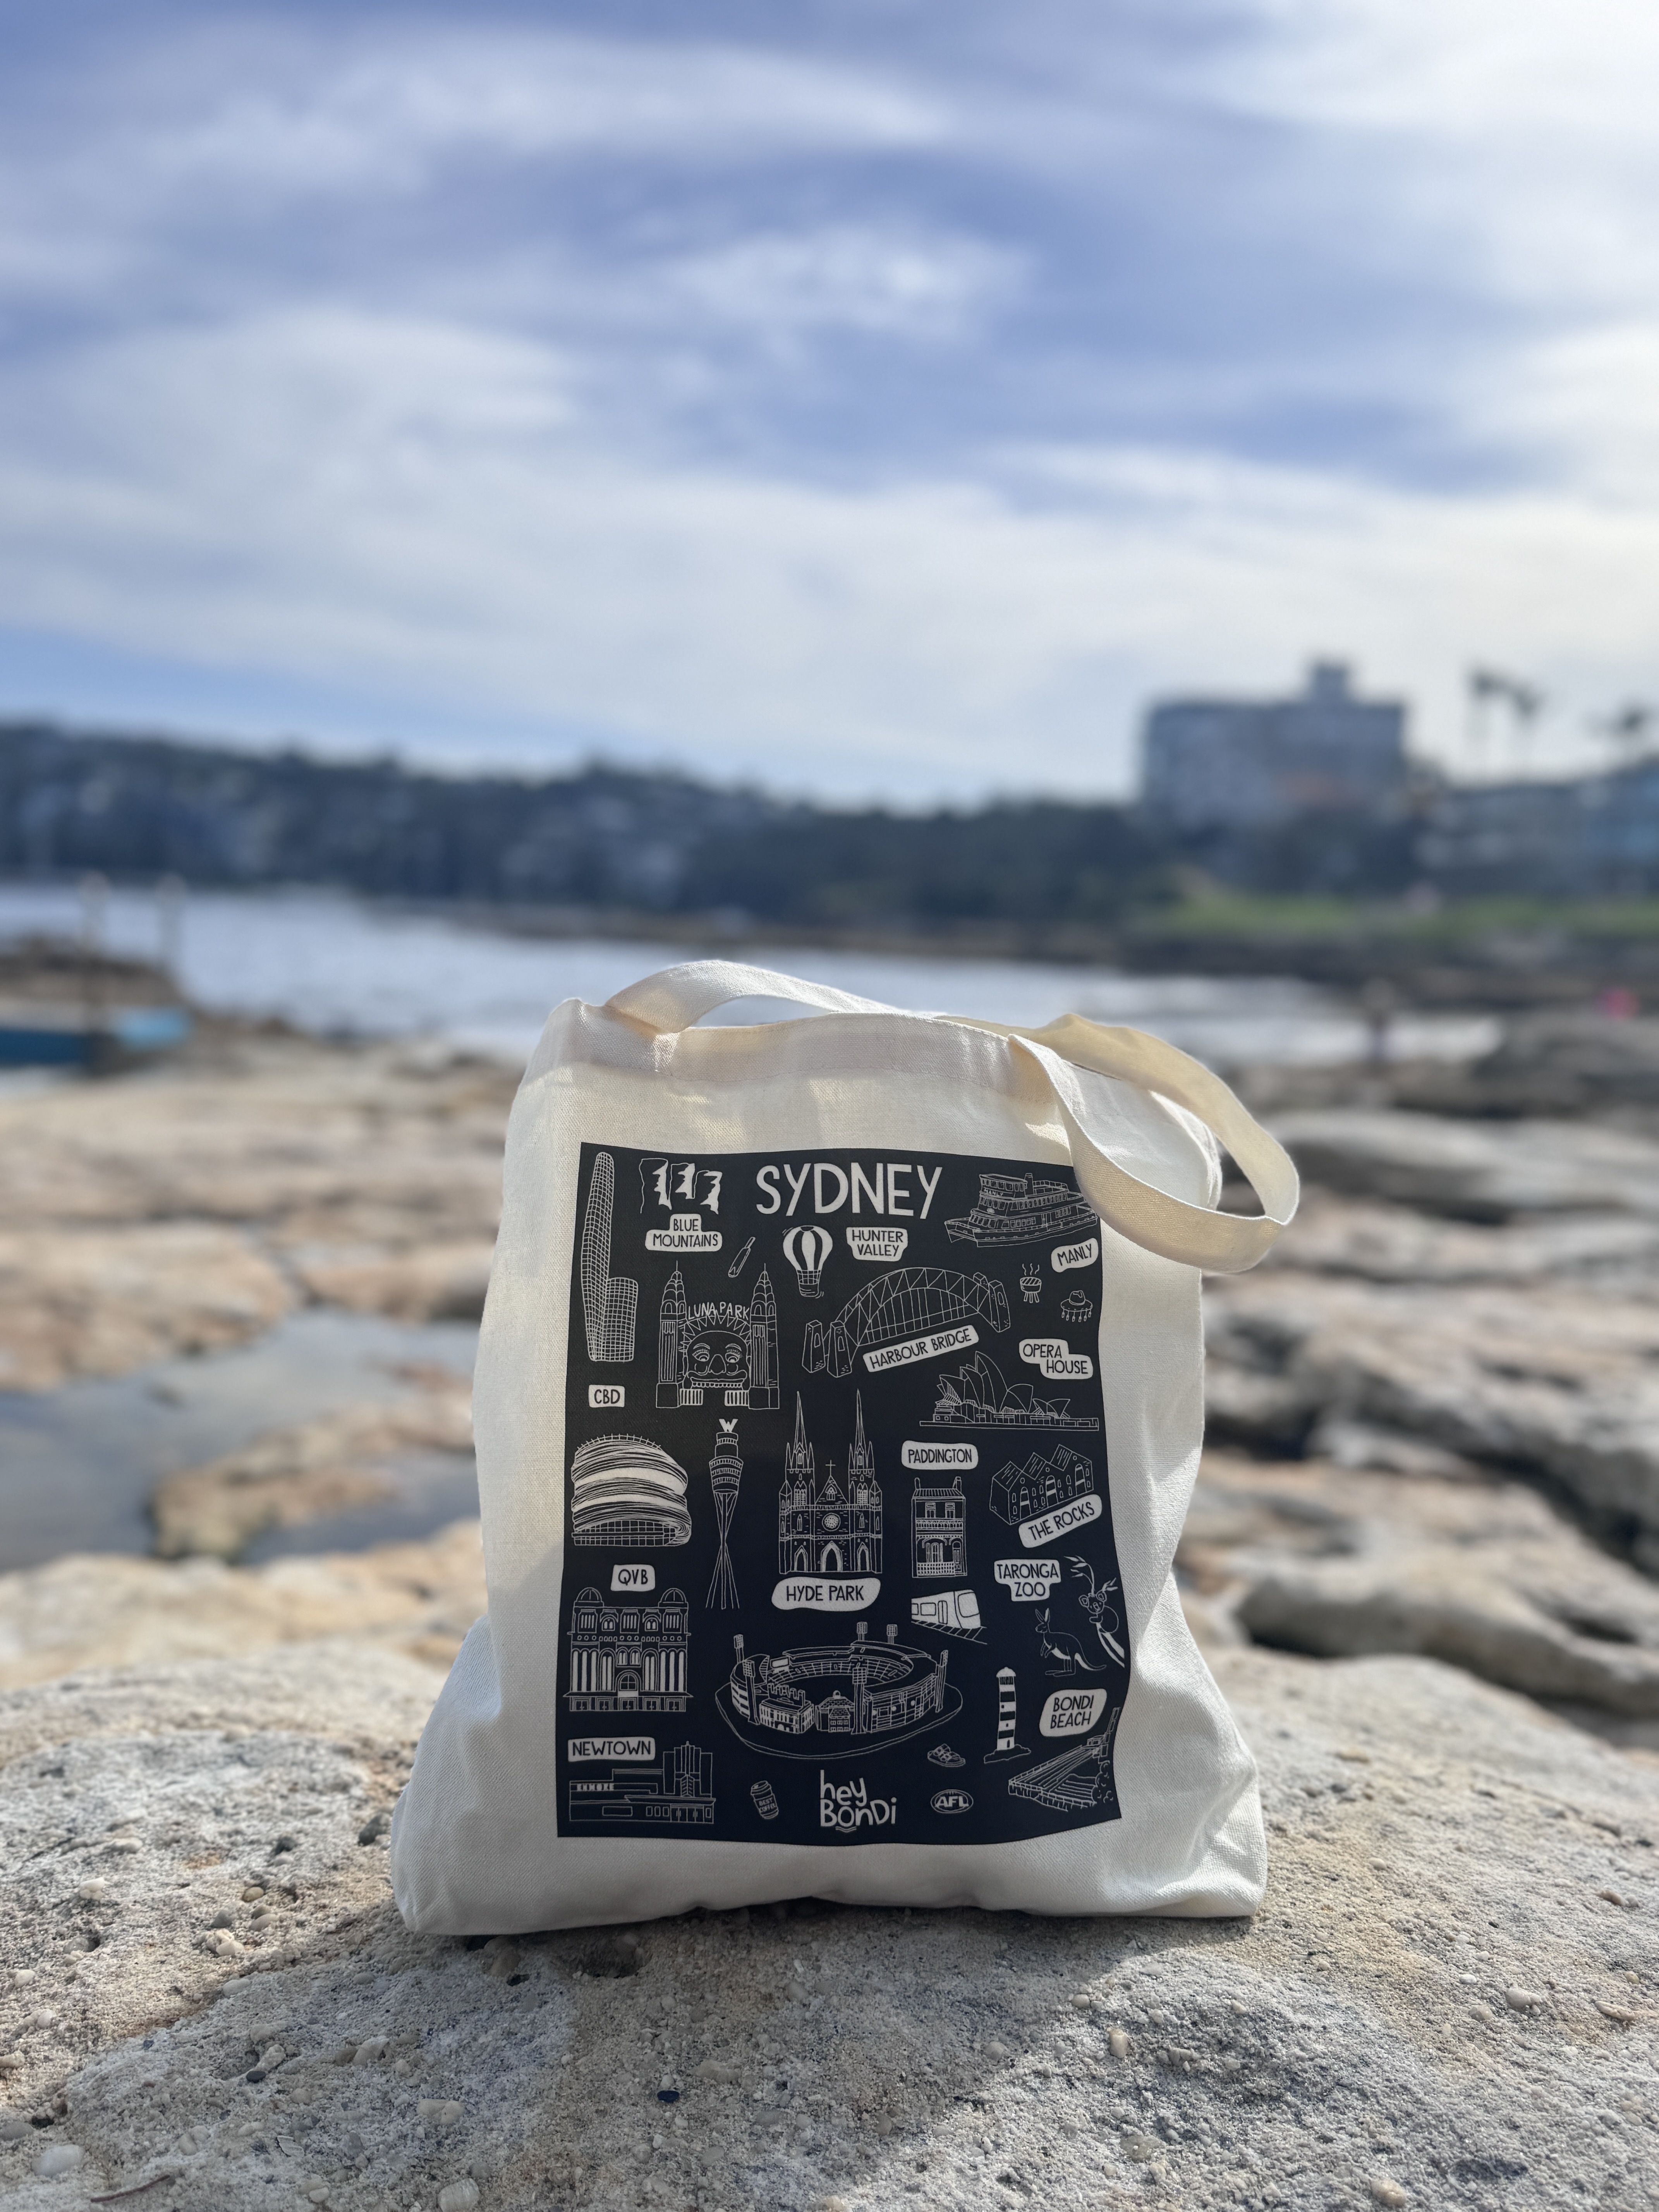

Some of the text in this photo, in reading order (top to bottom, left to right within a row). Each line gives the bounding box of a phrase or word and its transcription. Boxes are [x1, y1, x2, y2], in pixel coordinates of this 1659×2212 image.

[756, 1162, 943, 1219] SYDNEY
[983, 1188, 1003, 1197] MANLY
[673, 1218, 699, 1231] BLUE
[653, 1233, 719, 1248] MOUNTAINS
[852, 1230, 904, 1243] HUNTER
[857, 1244, 900, 1257] VALLEY
[1057, 1243, 1093, 1266] MANLY
[689, 1302, 750, 1321] LUNA PARK
[869, 1328, 972, 1369] HARBOUR BRIDGE
[1022, 1343, 1063, 1359] OPERA
[1046, 1359, 1089, 1374] HOUSE
[594, 1388, 621, 1405] CBD
[908, 1448, 972, 1464] PADDINGTON
[1028, 1501, 1095, 1541] THE ROCKS
[618, 1569, 649, 1587] QVB
[997, 1563, 1060, 1579] TARONGA
[786, 1585, 864, 1602] HYDE PARK
[1015, 1582, 1046, 1597] ZOO
[1053, 1695, 1095, 1712] BONDI
[1050, 1712, 1092, 1729] BEACH
[572, 1740, 651, 1756] NEWTOWN
[820, 1769, 867, 1807] hey
[759, 1797, 773, 1806] BEST
[935, 1796, 969, 1808] AFL
